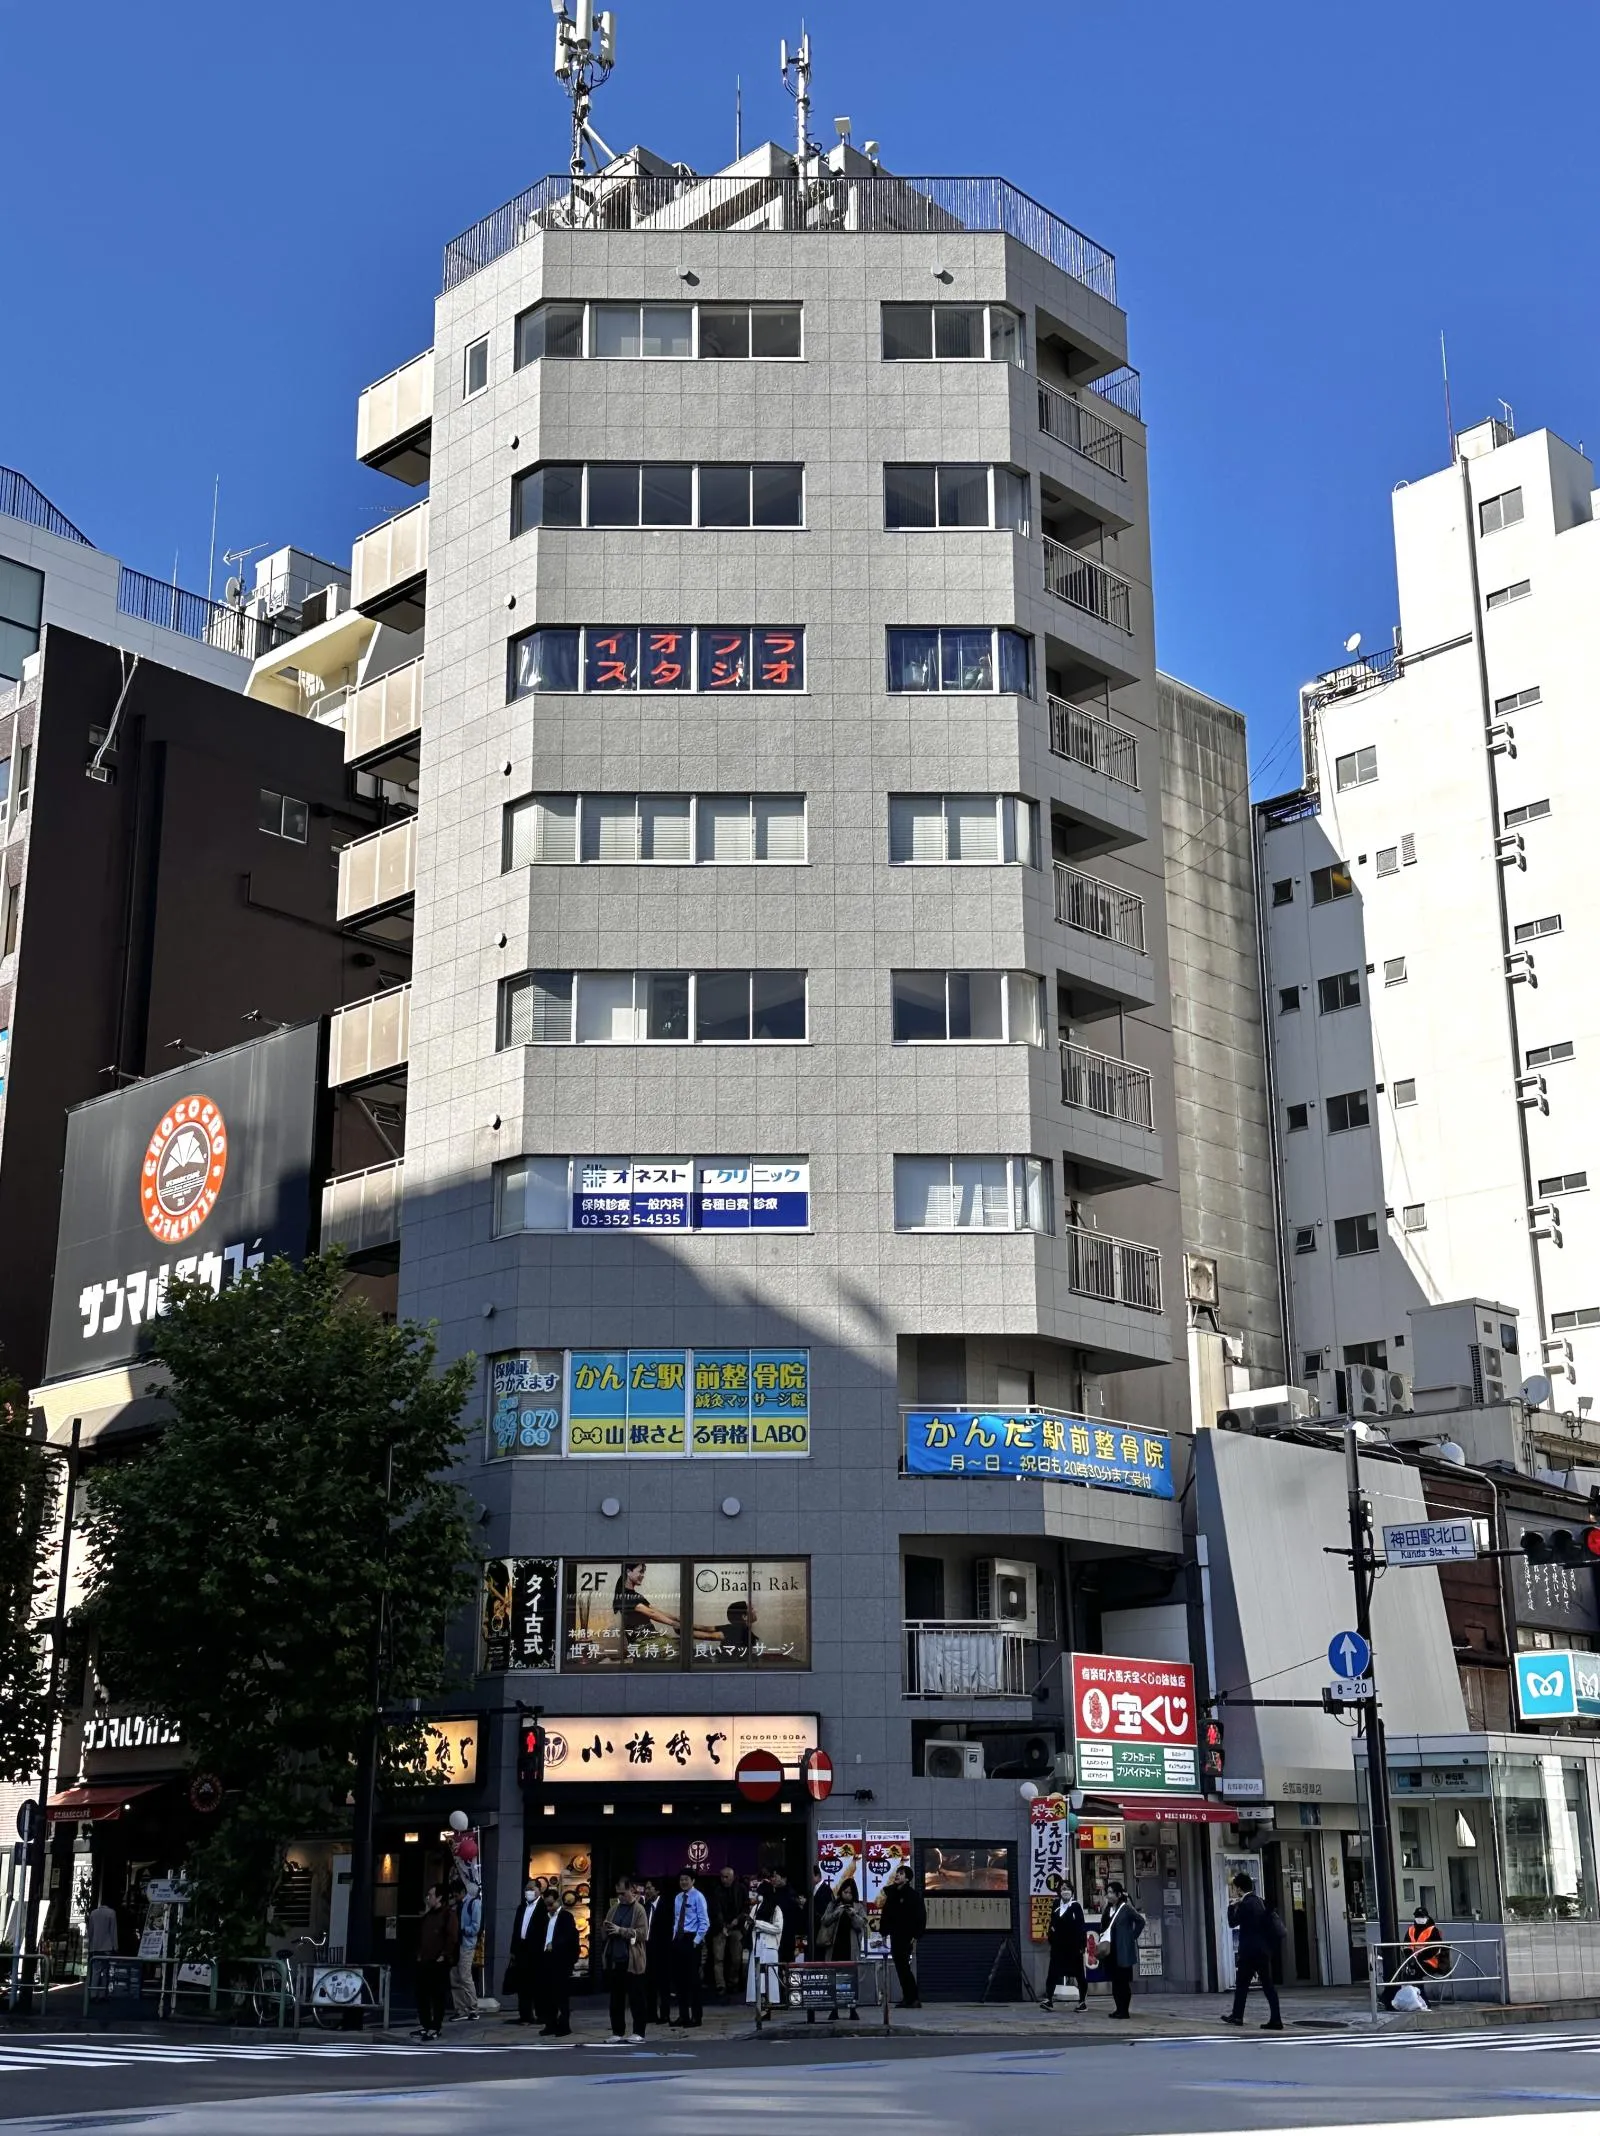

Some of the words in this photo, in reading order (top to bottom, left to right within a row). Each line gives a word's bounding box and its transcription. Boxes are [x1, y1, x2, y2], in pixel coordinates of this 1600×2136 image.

[582, 1199, 630, 1211] 保険診療
[635, 1197, 684, 1211] 一般内科
[701, 1198, 778, 1211] 各種自費診療
[581, 1214, 681, 1227] 03-3525-4535
[495, 1359, 531, 1379] 保険証
[575, 1362, 807, 1391] かんだ駅前整骨院
[495, 1374, 559, 1393] つかえます
[924, 1417, 1165, 1470] かんだ駅前整骨院
[1391, 1525, 1467, 1548] 神田駅北口
[1401, 1549, 1427, 1559] Kanda
[580, 1572, 608, 1591] 2F
[721, 1578, 762, 1592] Baan
[769, 1577, 799, 1591] Rak
[525, 1574, 544, 1655] タイ古式
[1112, 1692, 1189, 1736] 宝くじ
